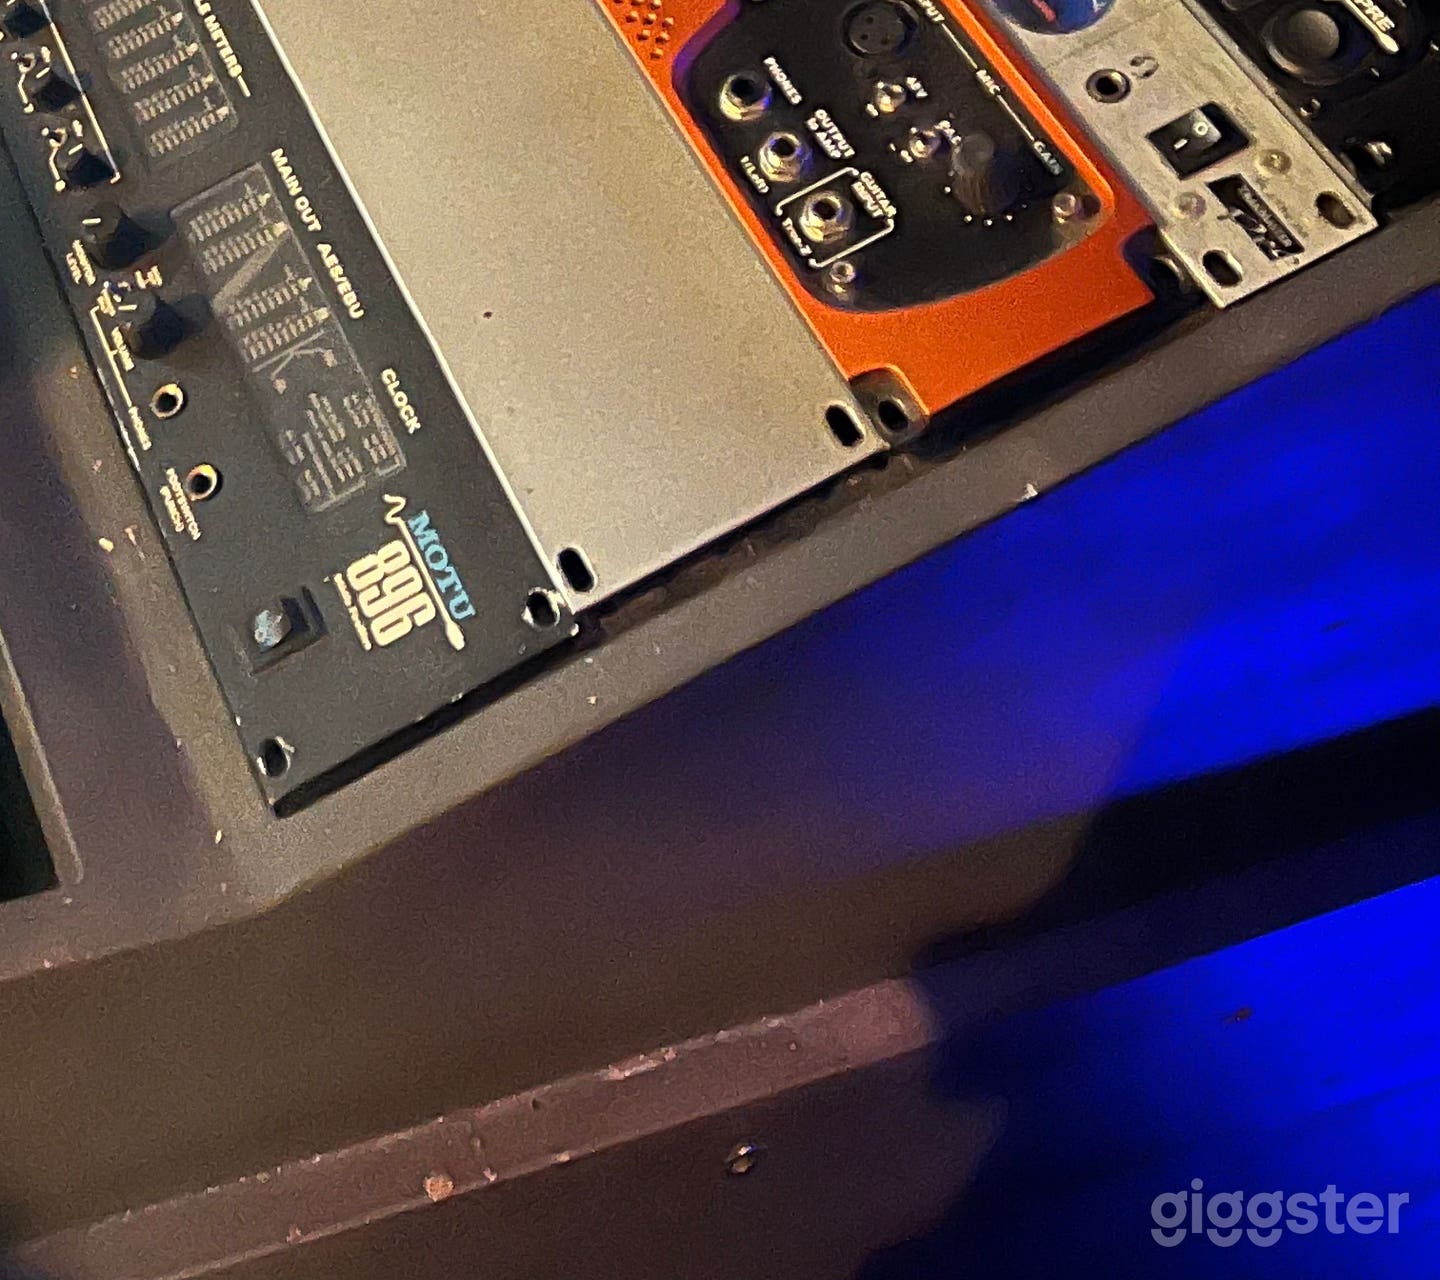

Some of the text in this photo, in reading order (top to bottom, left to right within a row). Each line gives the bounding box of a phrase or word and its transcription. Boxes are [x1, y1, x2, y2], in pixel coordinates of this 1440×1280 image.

[201, 13, 244, 79] METERS
[762, 55, 803, 105] PHONES
[813, 107, 856, 159] OUTPUT
[269, 147, 321, 234] MAIN OUT
[850, 180, 883, 219] INPUT
[857, 169, 898, 218] GUITAR
[315, 239, 365, 321] AES/EBU
[382, 369, 422, 434] CLOCK
[346, 539, 439, 649] 896
[406, 508, 477, 622] MOTU
